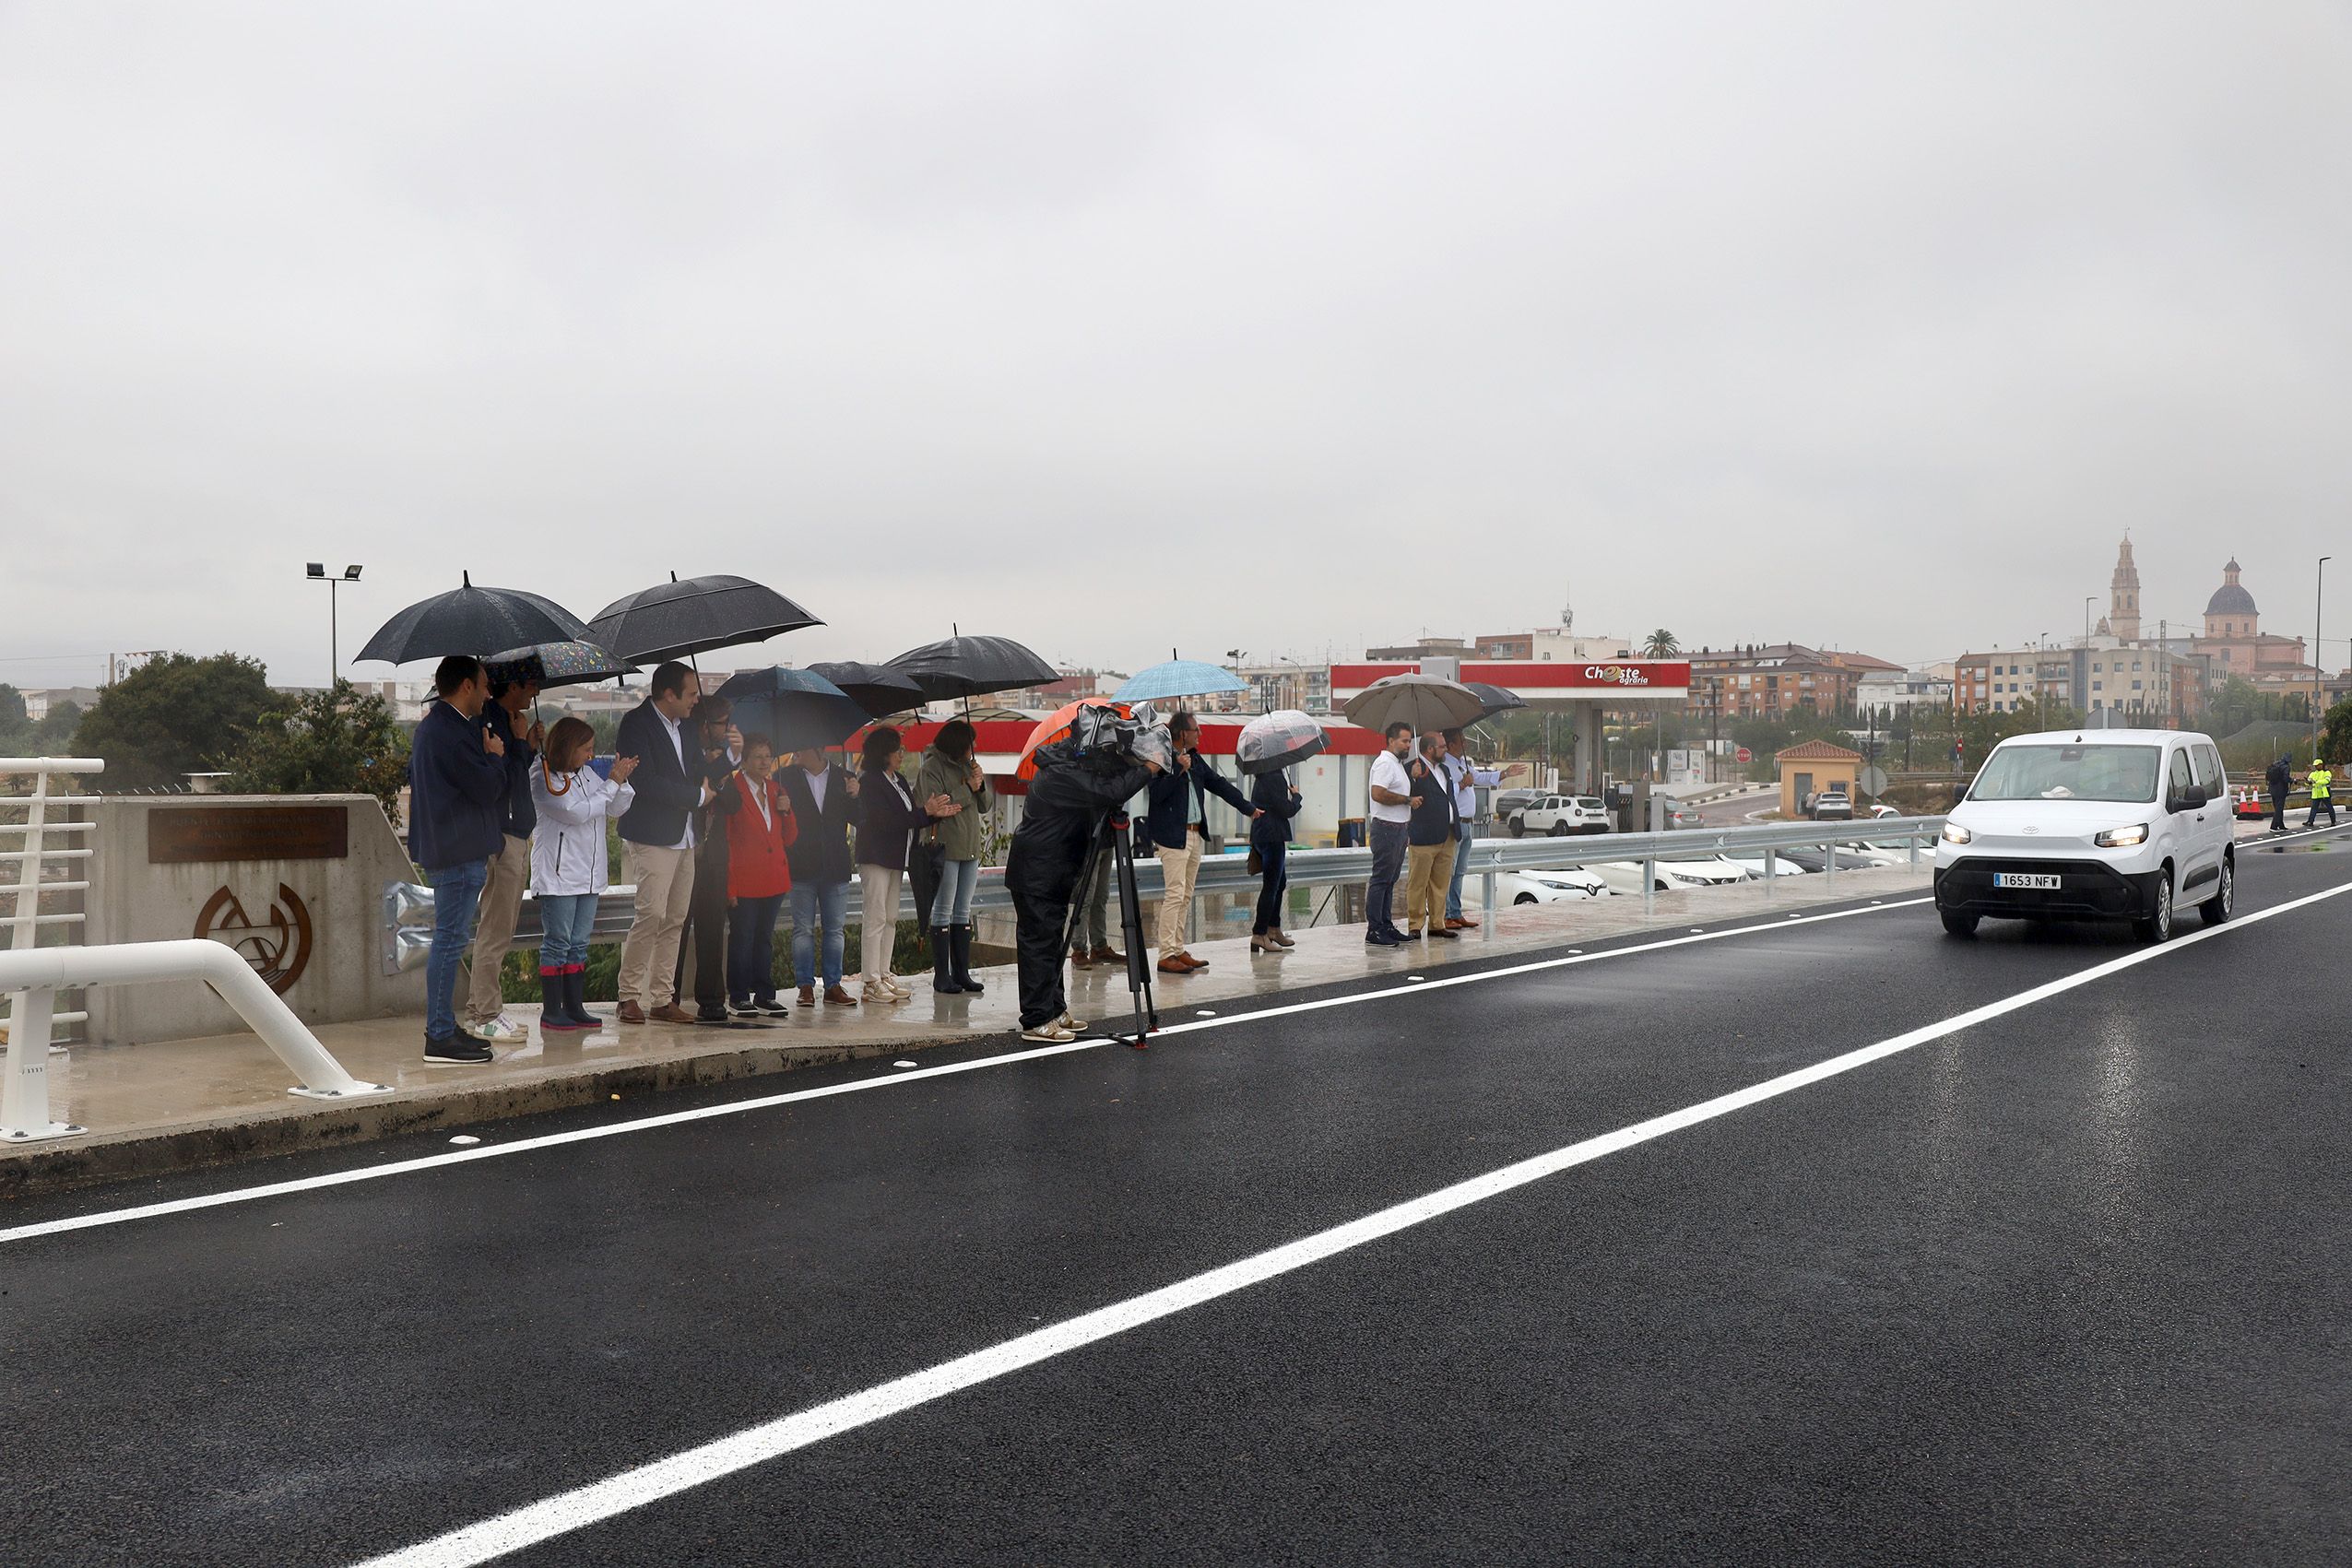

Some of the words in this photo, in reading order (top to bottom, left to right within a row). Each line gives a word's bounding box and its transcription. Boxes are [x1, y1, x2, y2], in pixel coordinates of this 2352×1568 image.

[1619, 676, 1649, 686] agraria
[2003, 875, 2031, 886] 1653
[2035, 877, 2059, 887] NFW
